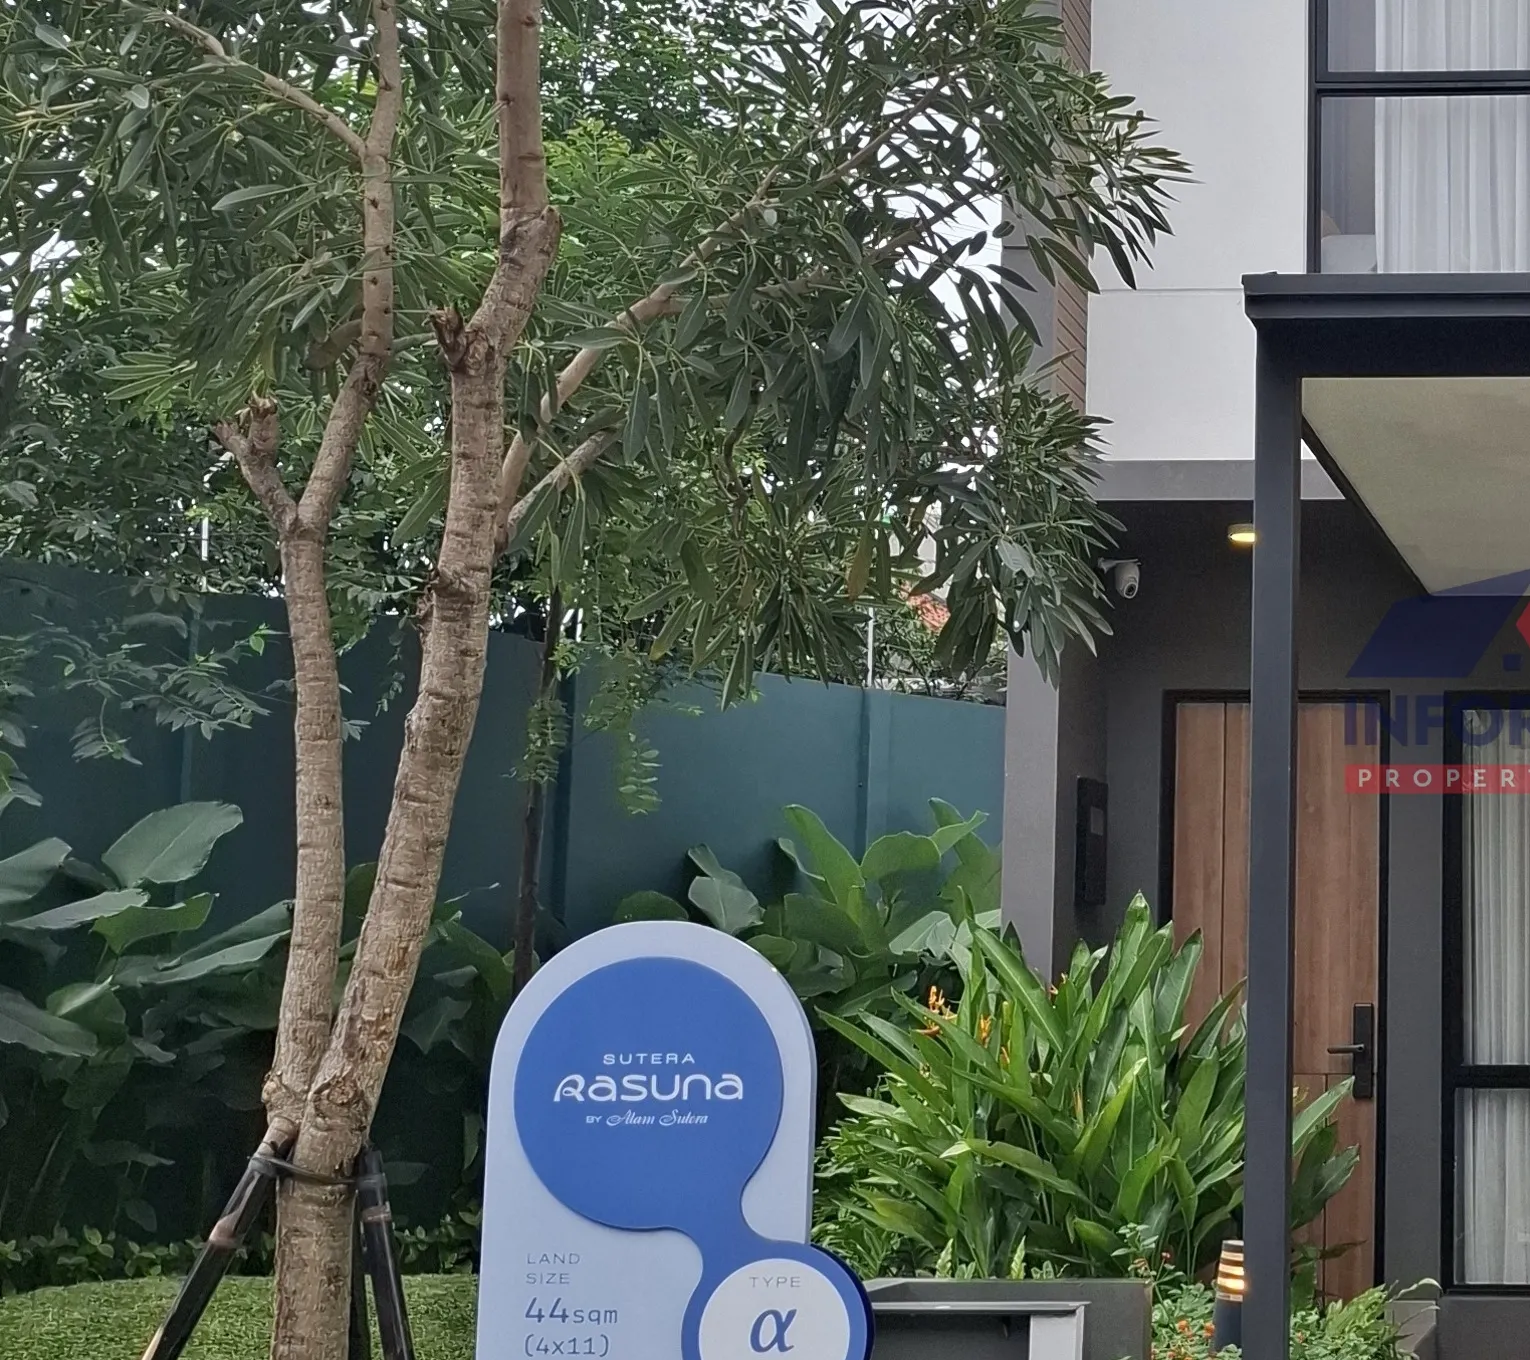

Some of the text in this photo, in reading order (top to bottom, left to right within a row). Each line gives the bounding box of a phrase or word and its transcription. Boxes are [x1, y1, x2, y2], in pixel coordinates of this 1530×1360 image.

[602, 1052, 696, 1065] SUTERA
[585, 1115, 603, 1124] BY
[605, 1109, 655, 1127] Alam
[526, 1252, 581, 1266] LAND
[525, 1272, 571, 1285] SIZE
[748, 1276, 802, 1289] TYPE
[524, 1296, 618, 1326] 44sqm
[523, 1333, 611, 1358] (4x11)
